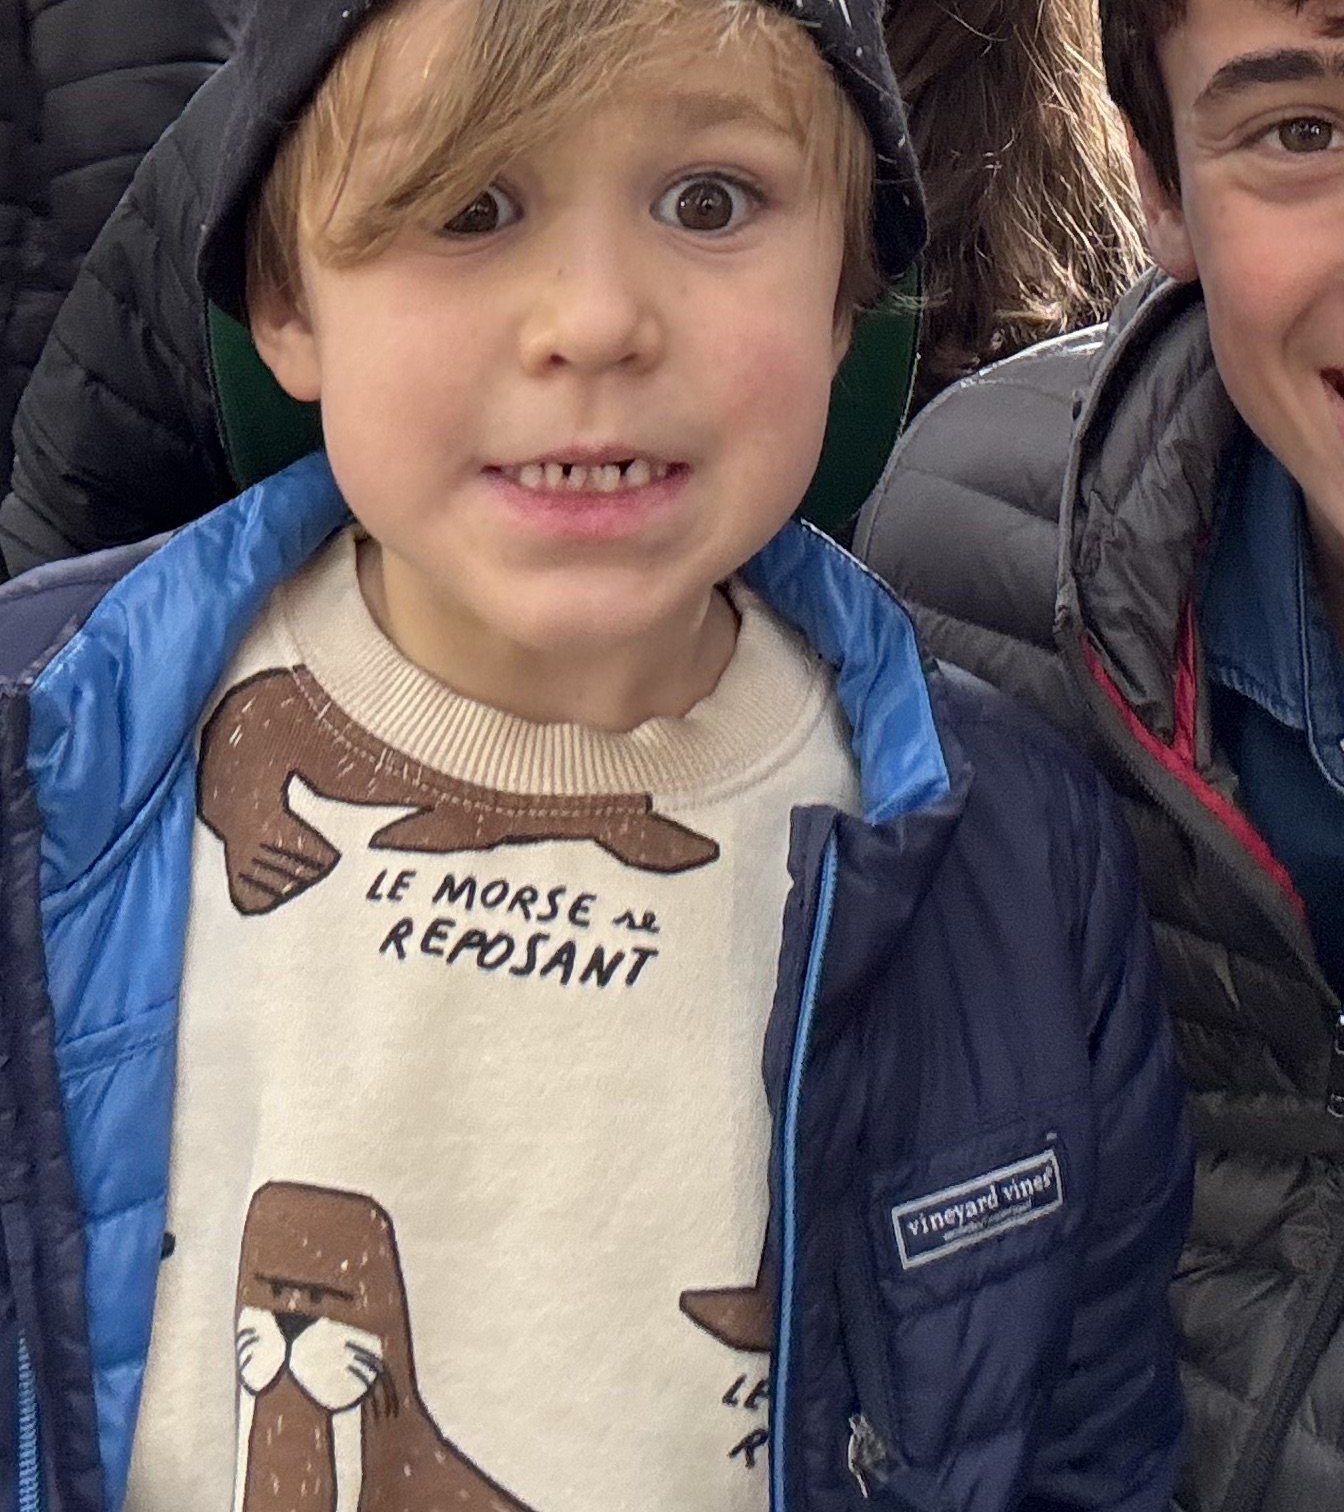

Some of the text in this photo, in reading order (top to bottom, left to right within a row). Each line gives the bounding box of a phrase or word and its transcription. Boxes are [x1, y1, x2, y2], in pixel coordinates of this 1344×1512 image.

[366, 869, 416, 902] LE
[432, 873, 597, 926] MORSE
[379, 916, 660, 988] REPOSANT
[907, 1184, 999, 1235] vineyard
[1003, 1166, 1053, 1201] vines
